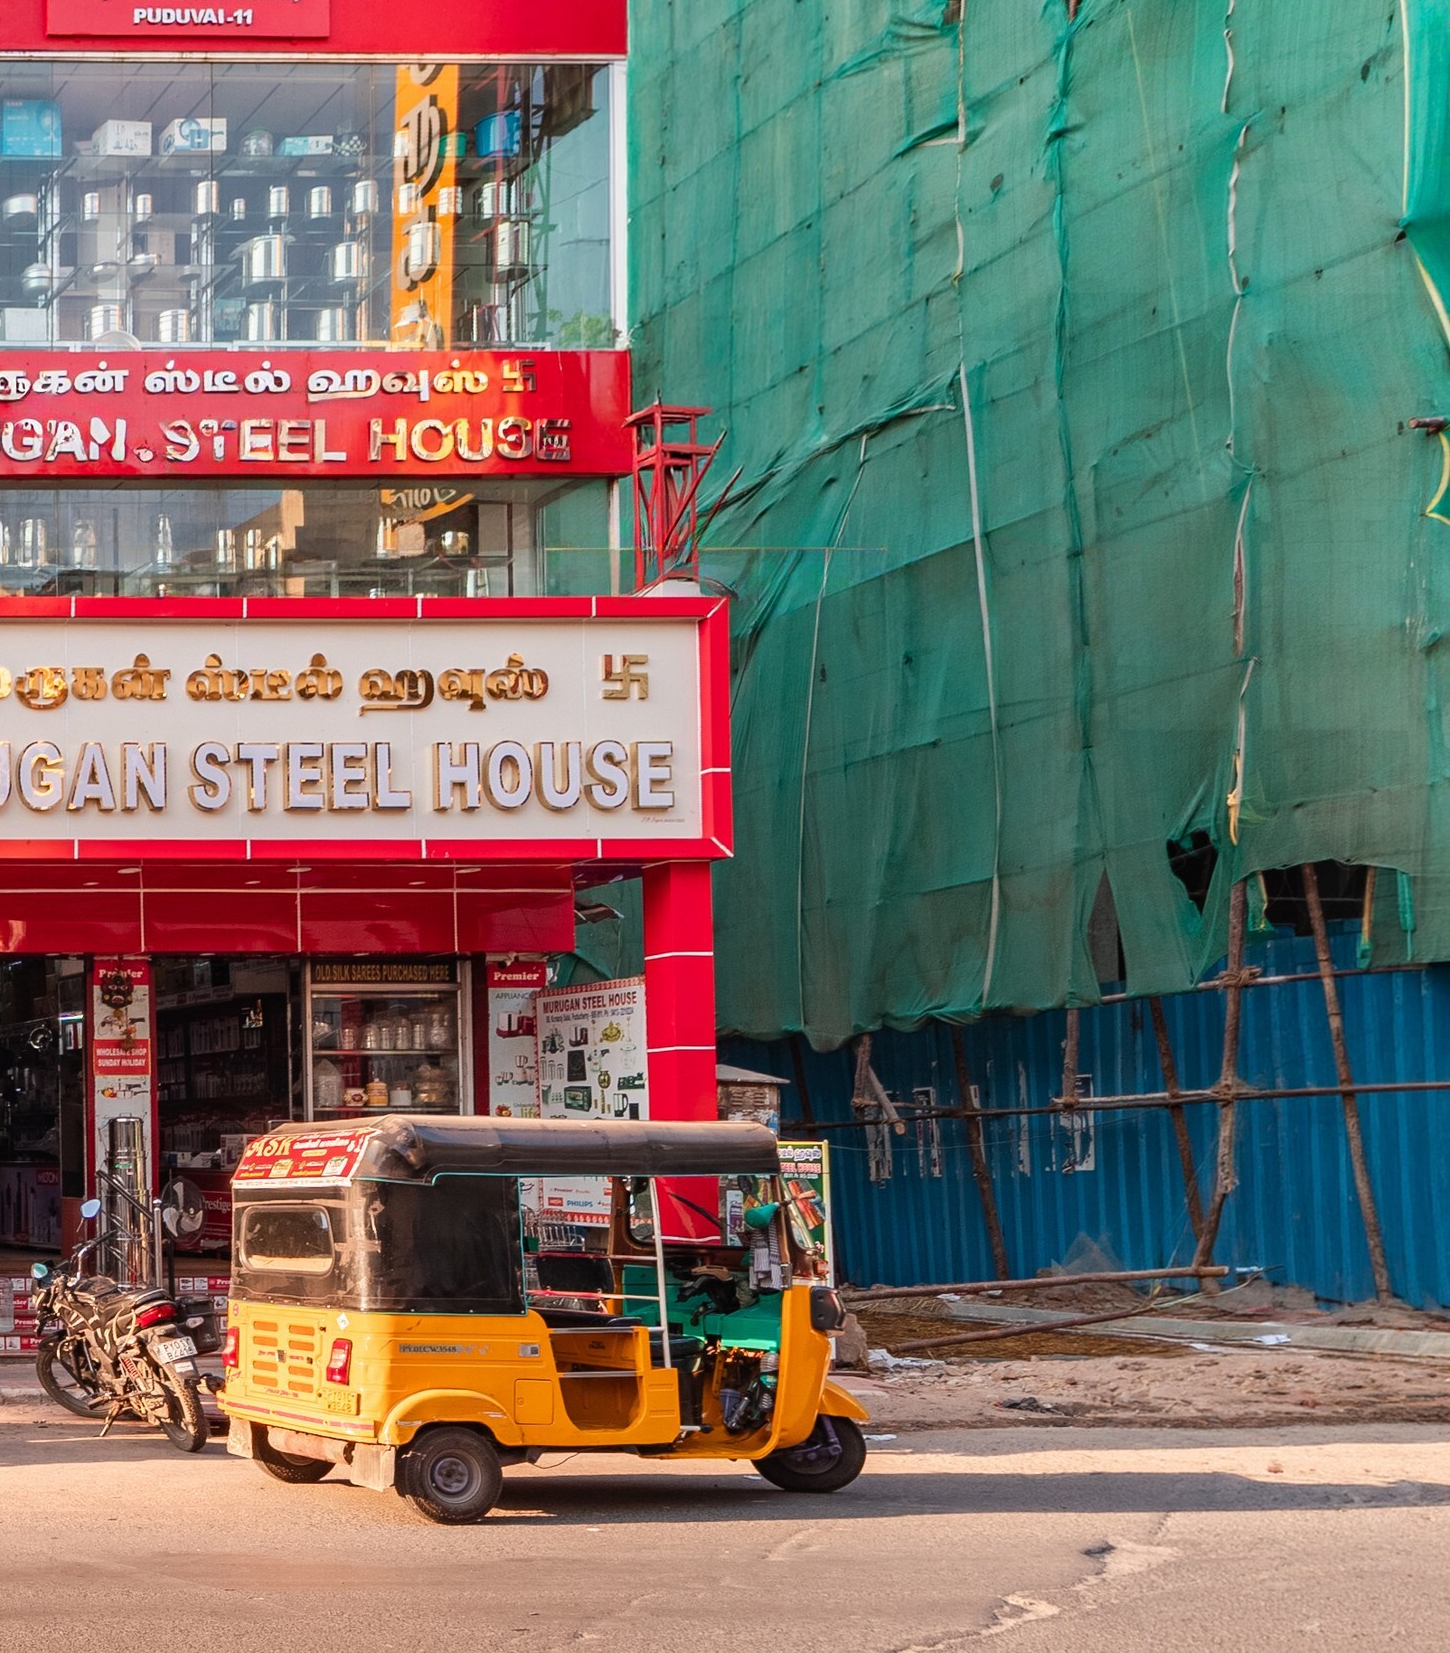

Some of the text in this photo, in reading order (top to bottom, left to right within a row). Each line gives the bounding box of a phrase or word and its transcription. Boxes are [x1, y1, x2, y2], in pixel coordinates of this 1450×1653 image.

[133, 7, 254, 27] PUDUVAI-11
[145, 360, 292, 394] ஸ்டீல்
[308, 359, 489, 402] ஹவுஸ்
[162, 417, 347, 462] STEEL
[368, 416, 571, 462] HOUSE
[185, 652, 343, 702] ஸ்டீல்
[358, 651, 550, 717] ஹவுஸ்
[187, 741, 412, 812] STEEL
[433, 740, 676, 811] HOUSE
[315, 964, 450, 981] OLD SILK SAREES PURCHASED HERE
[493, 971, 539, 981] Premier
[496, 992, 531, 1000] APPLIANC
[543, 998, 580, 1014] MURUGAN
[582, 995, 607, 1010] STEEL
[608, 991, 638, 1007] HOUSE
[131, 1048, 147, 1056] SHOP
[97, 1058, 146, 1067] SUNDAY HOLIDAY
[567, 1200, 593, 1208] PHILIPS
